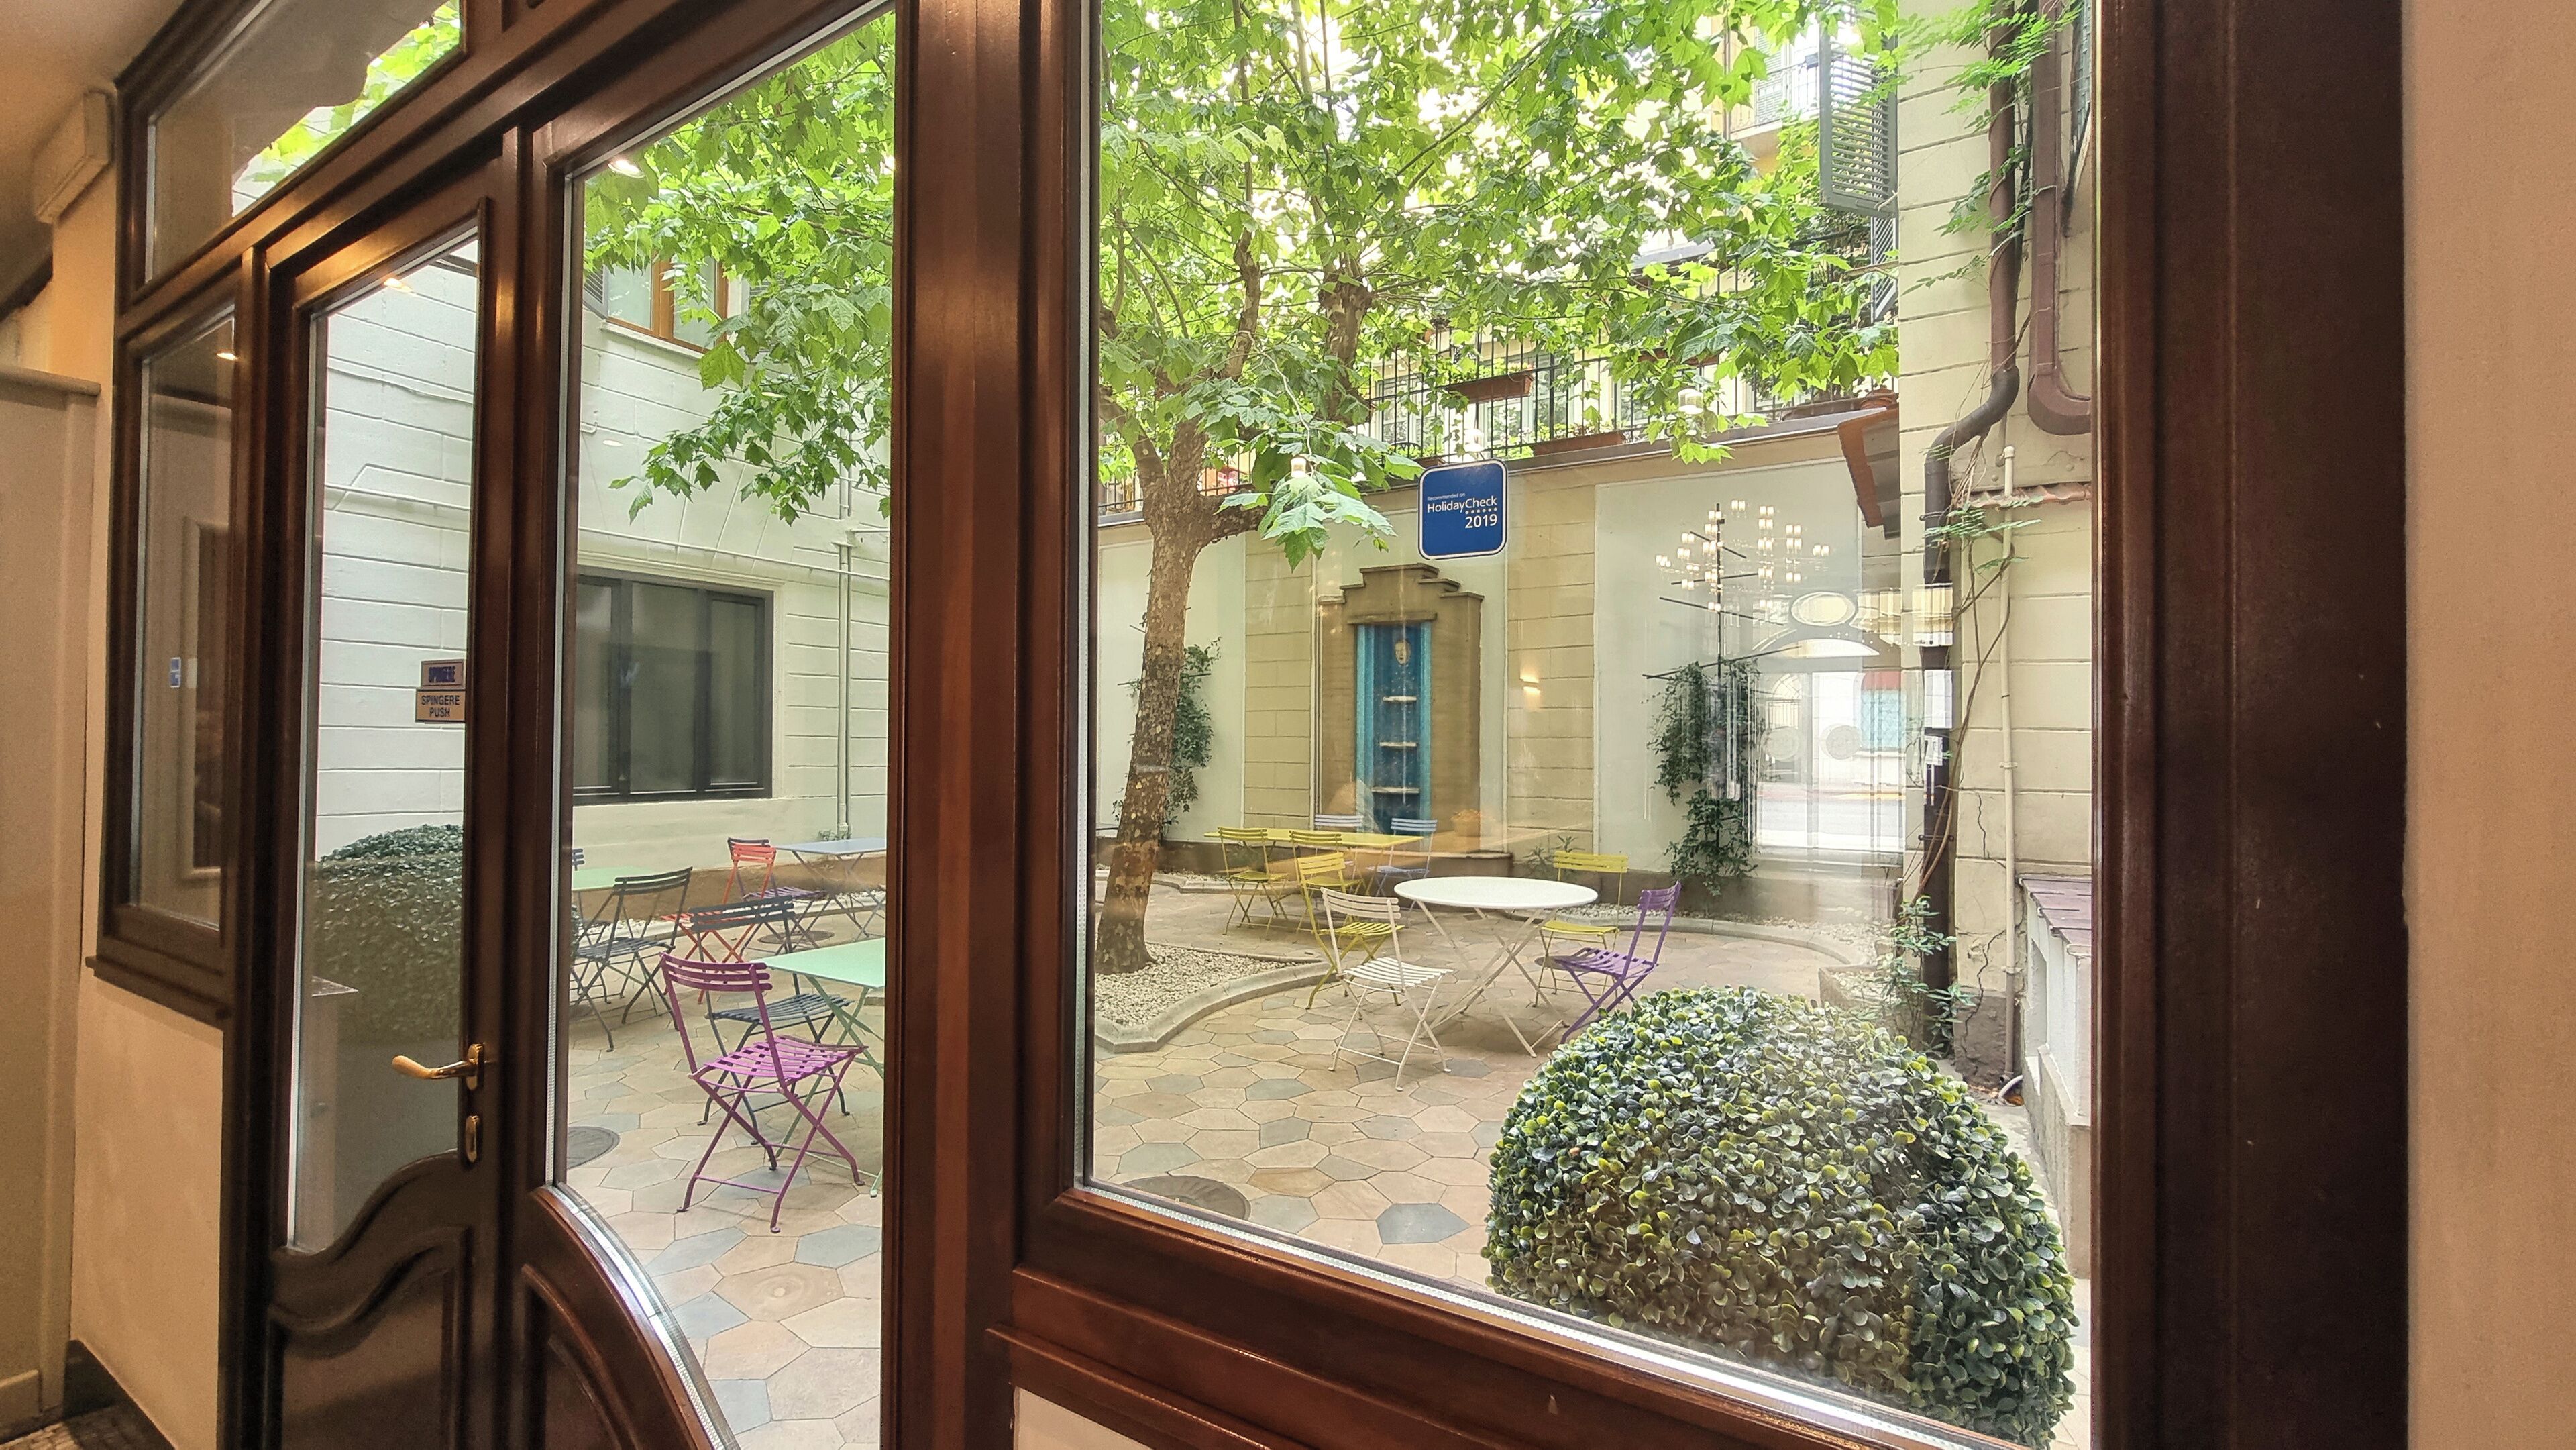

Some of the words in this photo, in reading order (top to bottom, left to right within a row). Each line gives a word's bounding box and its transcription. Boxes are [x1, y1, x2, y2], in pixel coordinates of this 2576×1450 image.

[1427, 495, 1497, 513] HolidayCheck
[1465, 514, 1497, 529] 2019
[421, 696, 460, 705] SPINGERE
[429, 707, 451, 717] PUSH
